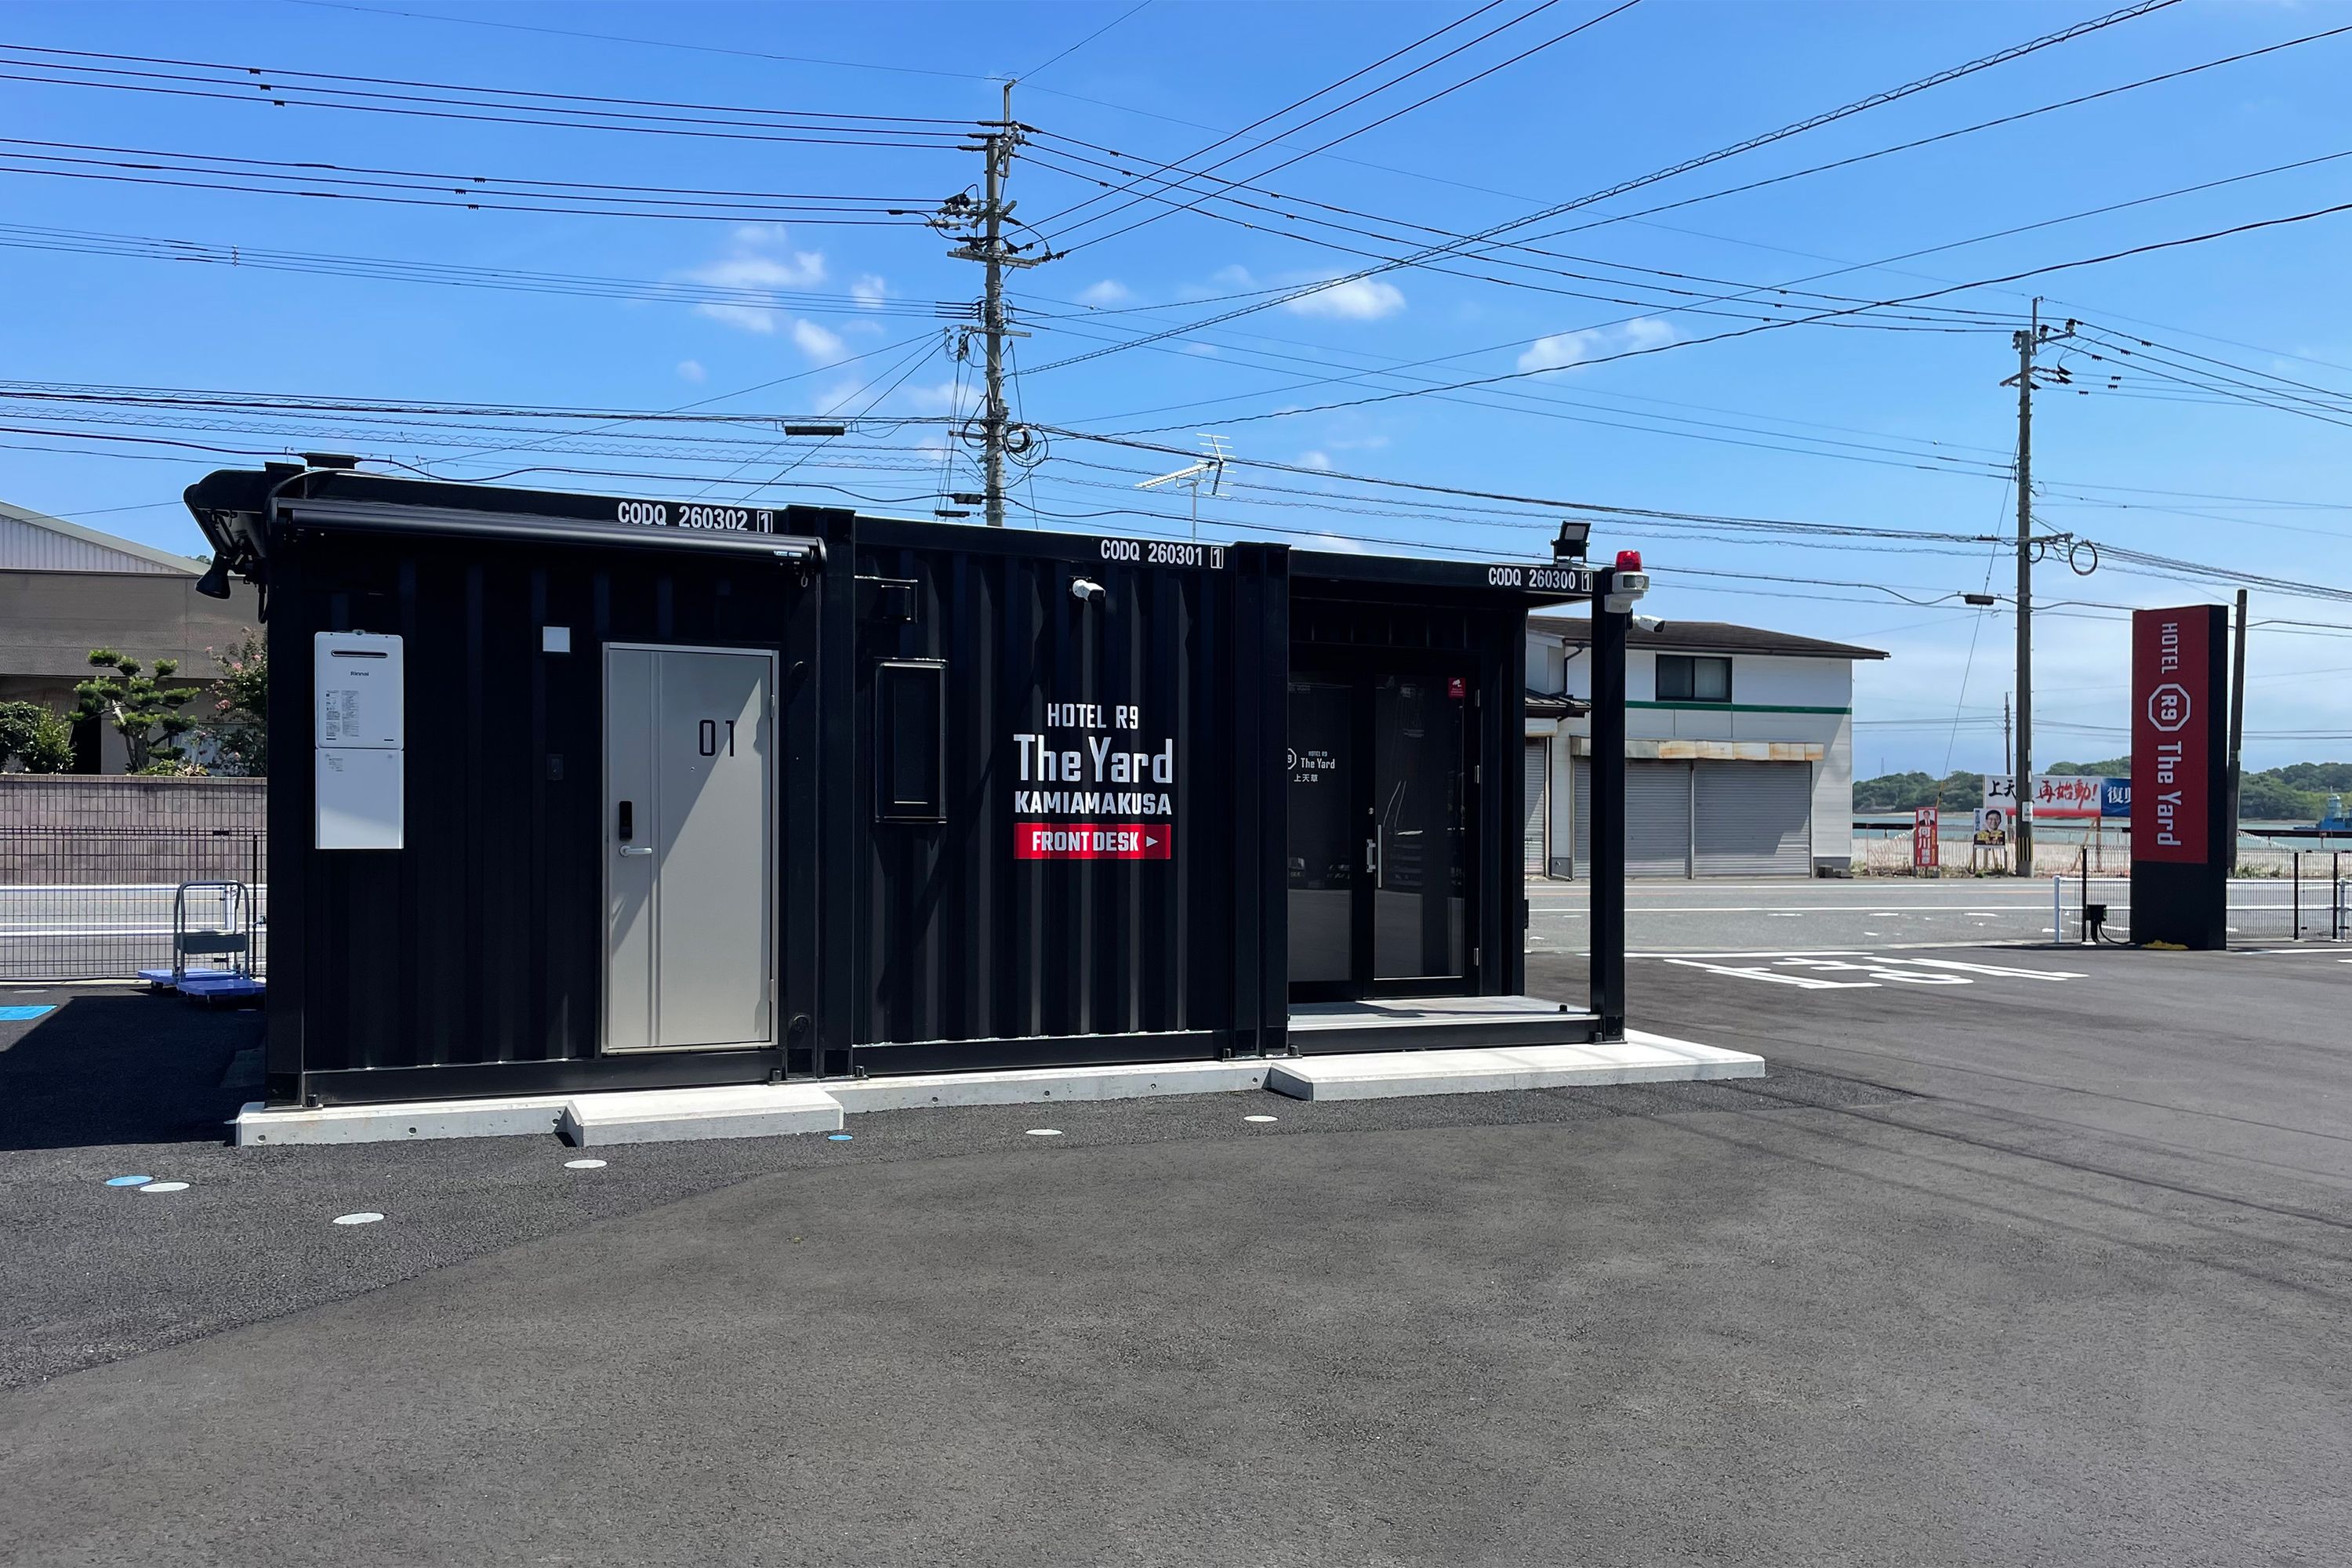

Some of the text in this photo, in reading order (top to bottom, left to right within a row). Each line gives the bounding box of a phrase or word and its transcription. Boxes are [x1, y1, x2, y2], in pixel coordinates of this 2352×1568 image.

[618, 502, 666, 525] CODQ
[678, 505, 747, 531] 260302
[1101, 539, 1140, 561] CODQ
[1148, 543, 1203, 565] 260301
[1488, 567, 1522, 586] CODQ
[1529, 568, 1576, 590] 260300
[1047, 702, 1139, 729] HOTEL R9
[699, 719, 735, 757] 01
[2158, 622, 2182, 846] HOTEL R9 The Yard
[1014, 734, 1173, 784] The Yard
[1300, 757, 1335, 769] The Yard
[1294, 773, 1319, 782] 上天草
[1014, 790, 1172, 815] KAMIAMAKUSA
[1033, 831, 1139, 852] FRONT DESK
